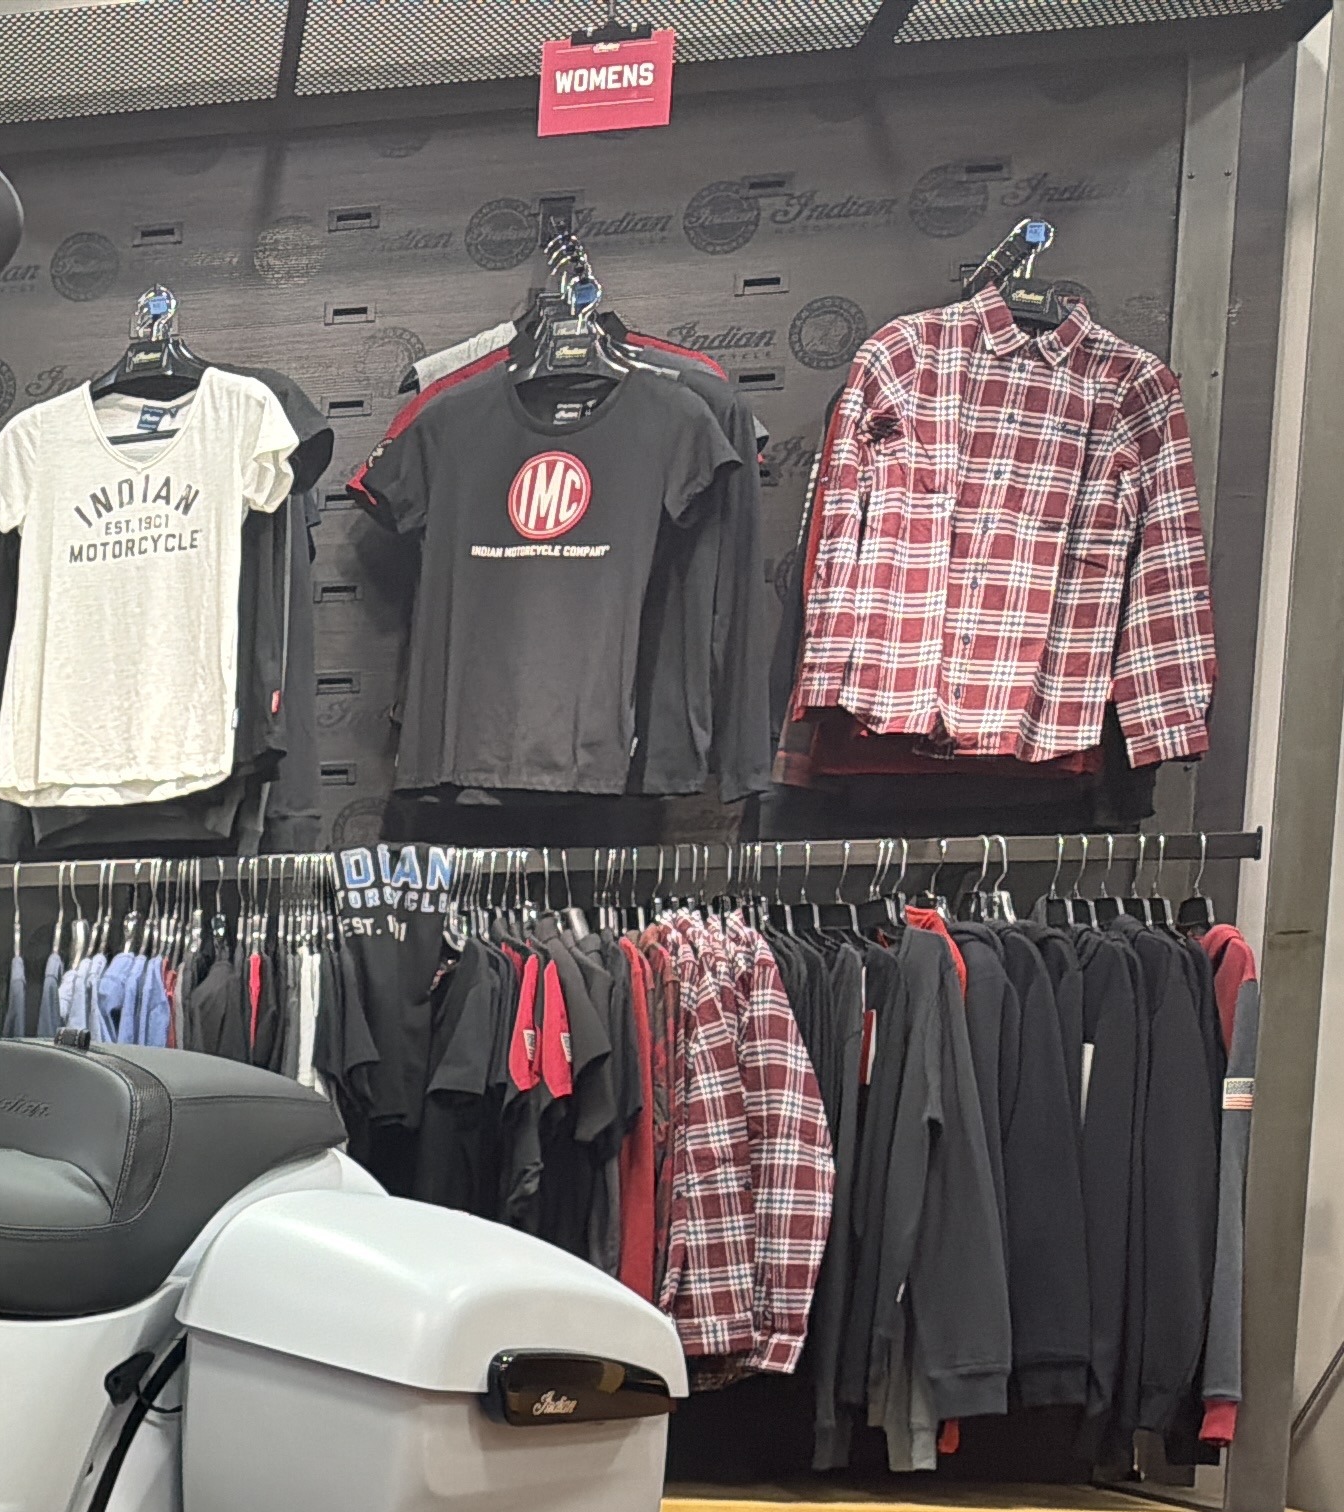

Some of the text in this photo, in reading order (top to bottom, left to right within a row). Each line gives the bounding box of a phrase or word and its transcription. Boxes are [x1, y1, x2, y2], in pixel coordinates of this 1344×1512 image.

[555, 62, 655, 94] WOMENS
[667, 321, 777, 350] Indian
[74, 474, 200, 528] INDIAN
[518, 461, 581, 530] IMC
[69, 529, 200, 563] MOTORCYCLE
[471, 545, 503, 557] INDIAN
[504, 545, 562, 558] MOTORCYCLE
[340, 843, 456, 891] DIAN
[532, 1390, 579, 1416] Indian
